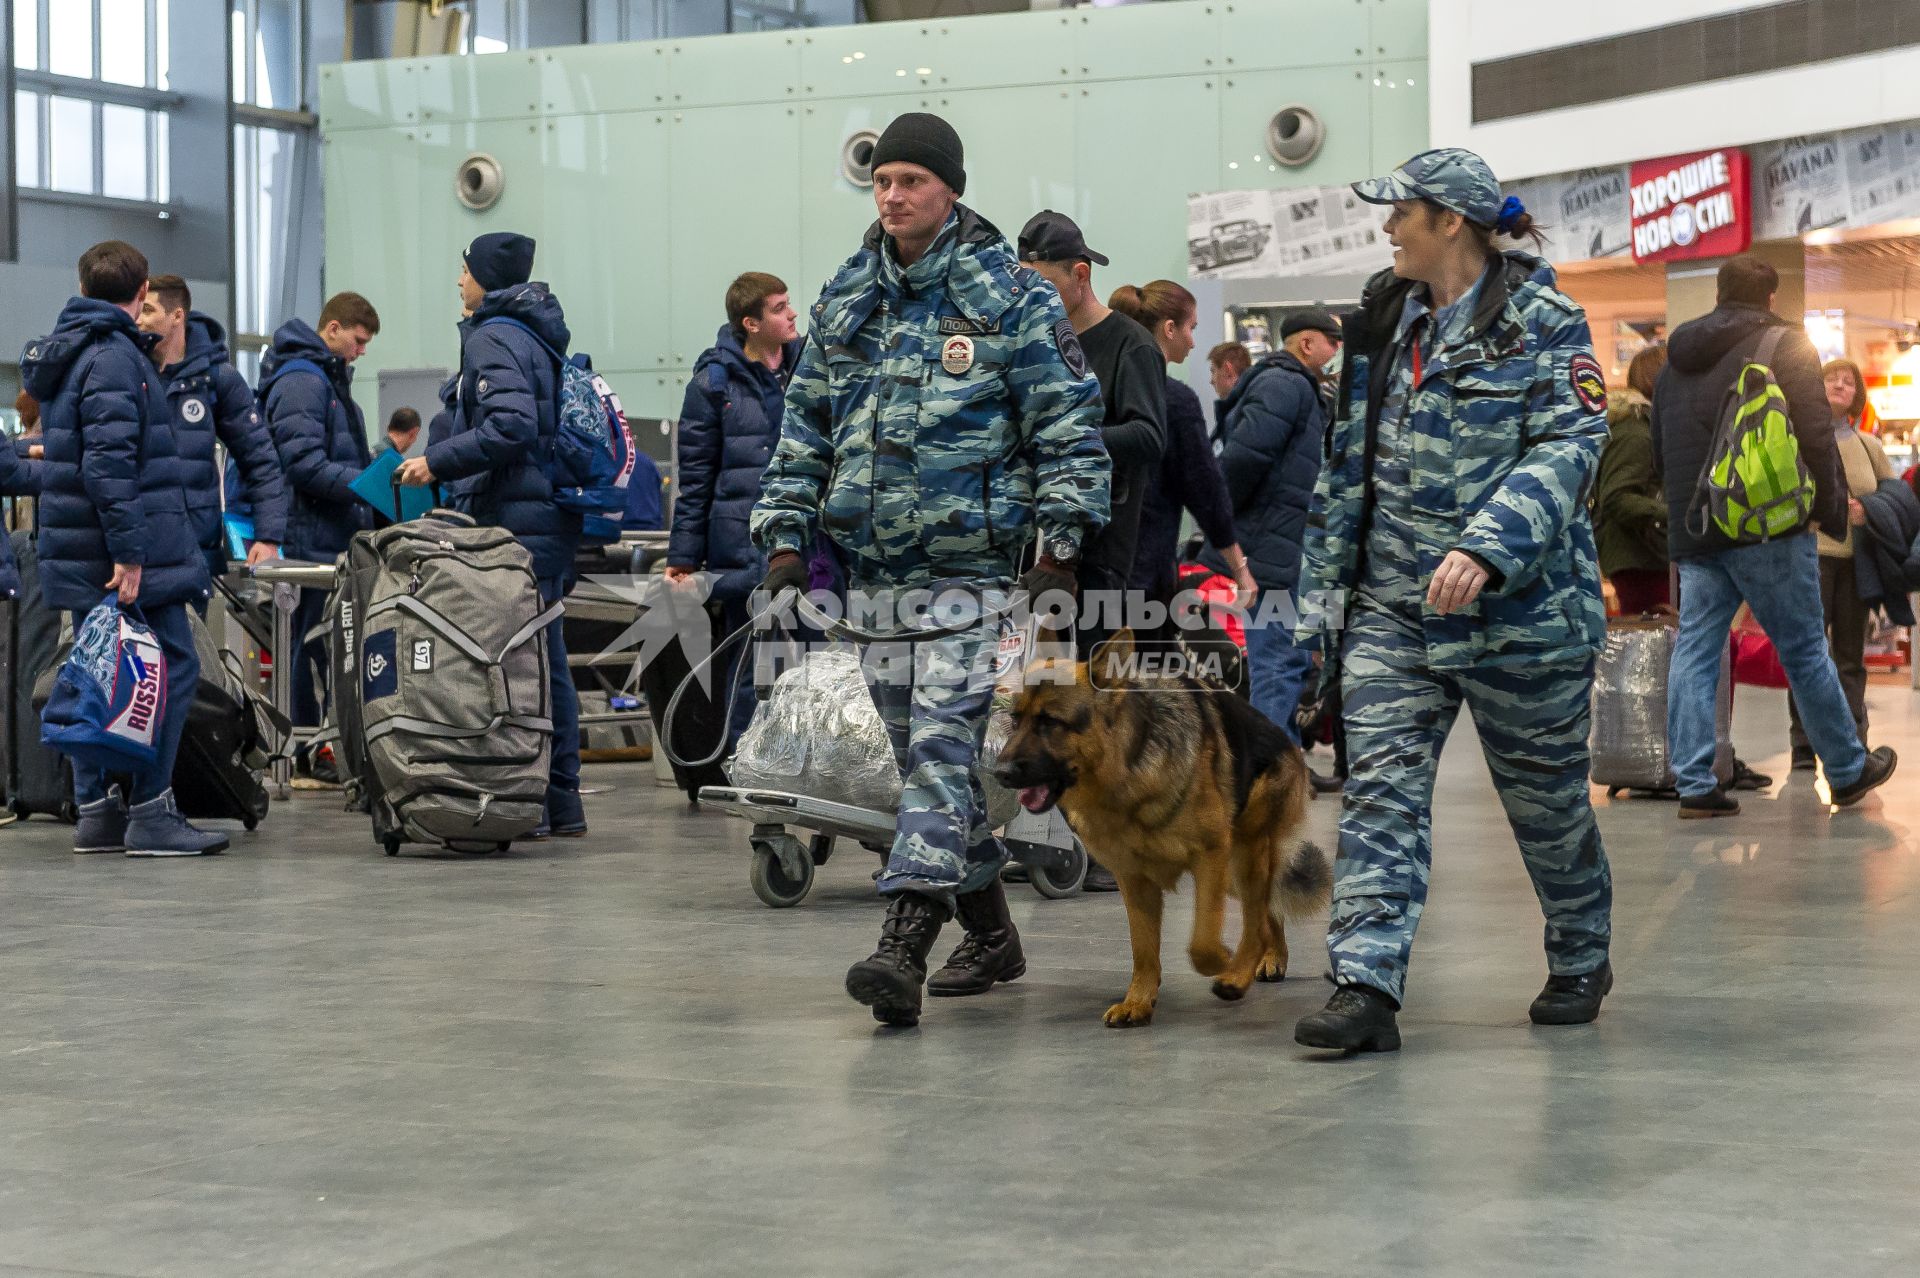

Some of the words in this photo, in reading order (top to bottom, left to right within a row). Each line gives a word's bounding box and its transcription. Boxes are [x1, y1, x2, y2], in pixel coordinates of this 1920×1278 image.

[1630, 152, 1730, 219] ХОРОШИЕ
[415, 646, 429, 664] 97
[126, 661, 159, 732] RUSSIA
